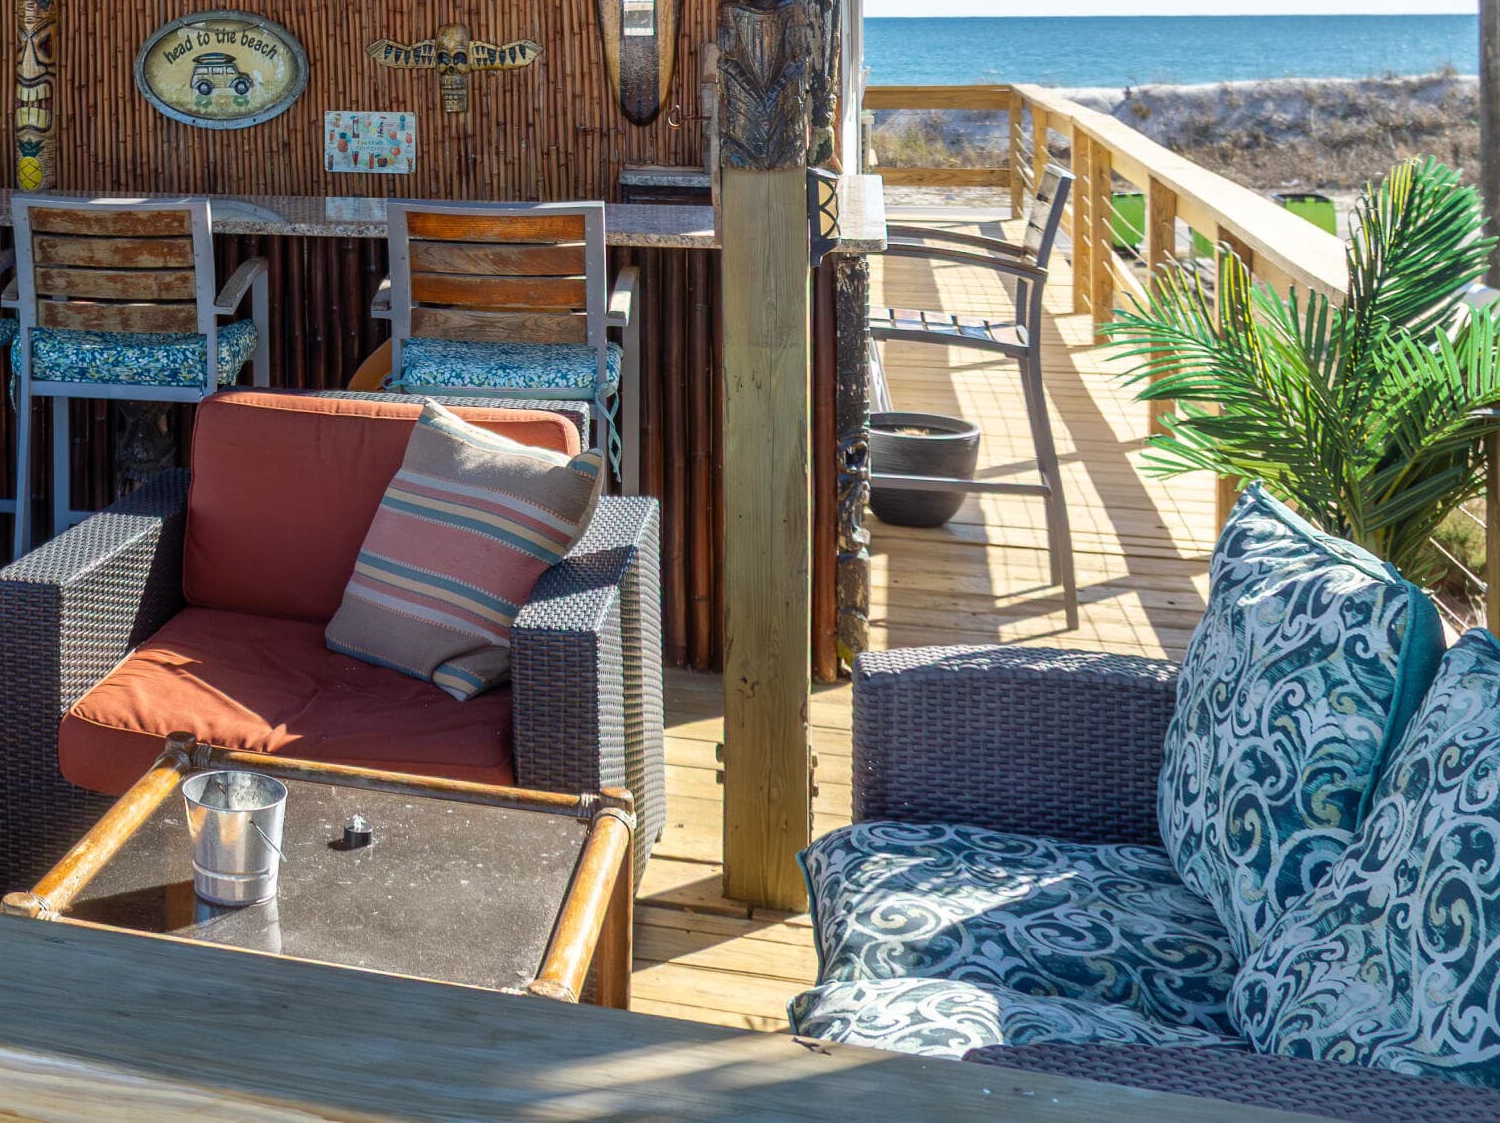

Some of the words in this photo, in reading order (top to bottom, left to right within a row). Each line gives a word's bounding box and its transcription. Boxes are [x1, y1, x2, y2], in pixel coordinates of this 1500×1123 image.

[163, 36, 193, 64] head
[197, 32, 210, 47] to
[215, 29, 237, 44] the
[240, 30, 277, 59] beach
